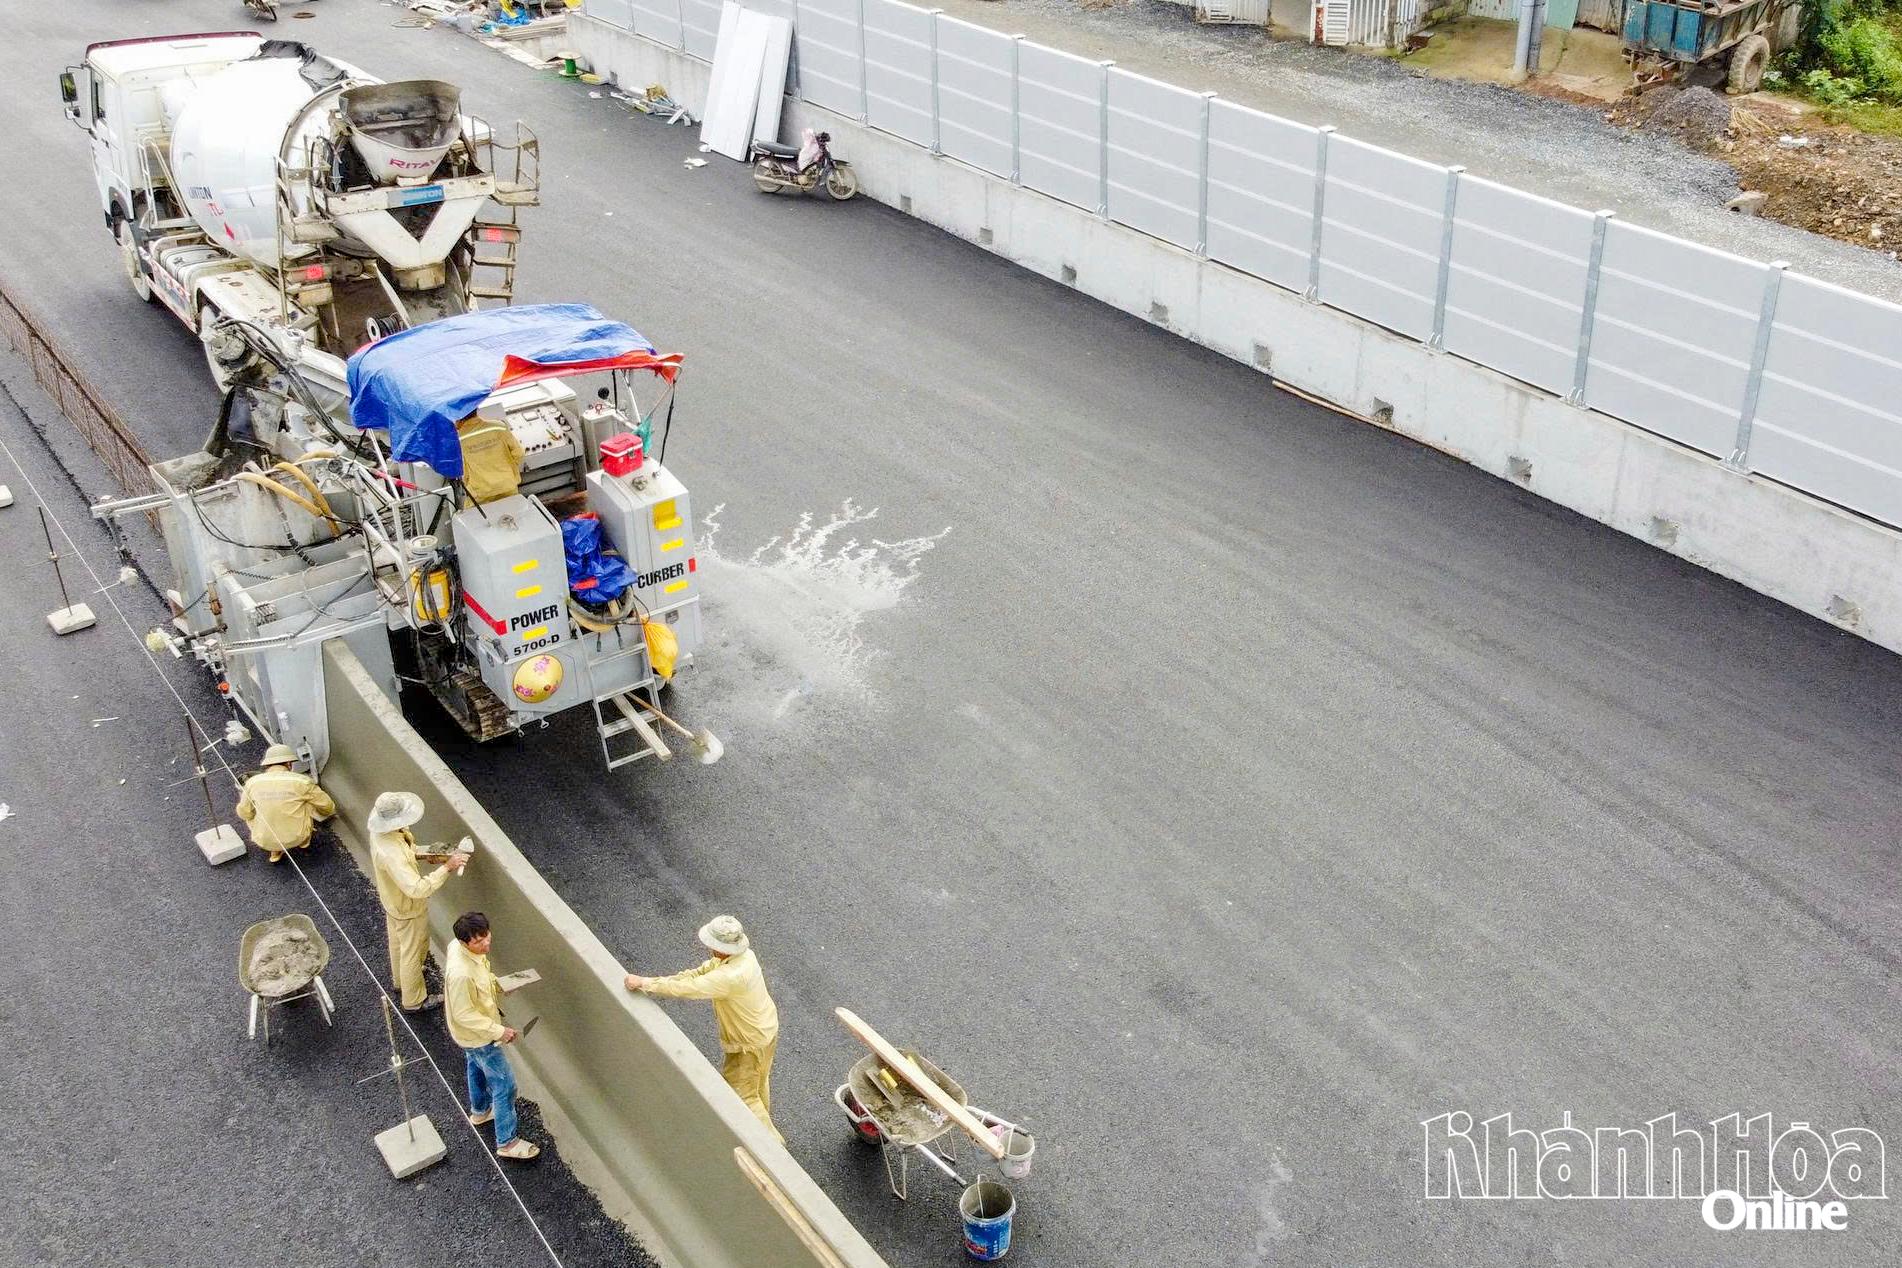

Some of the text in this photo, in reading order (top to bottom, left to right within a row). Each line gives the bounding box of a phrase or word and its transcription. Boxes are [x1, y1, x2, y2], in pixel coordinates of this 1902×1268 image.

[637, 562, 685, 589] CURBER
[511, 604, 559, 631] POWER
[513, 633, 560, 656] 5700-D
